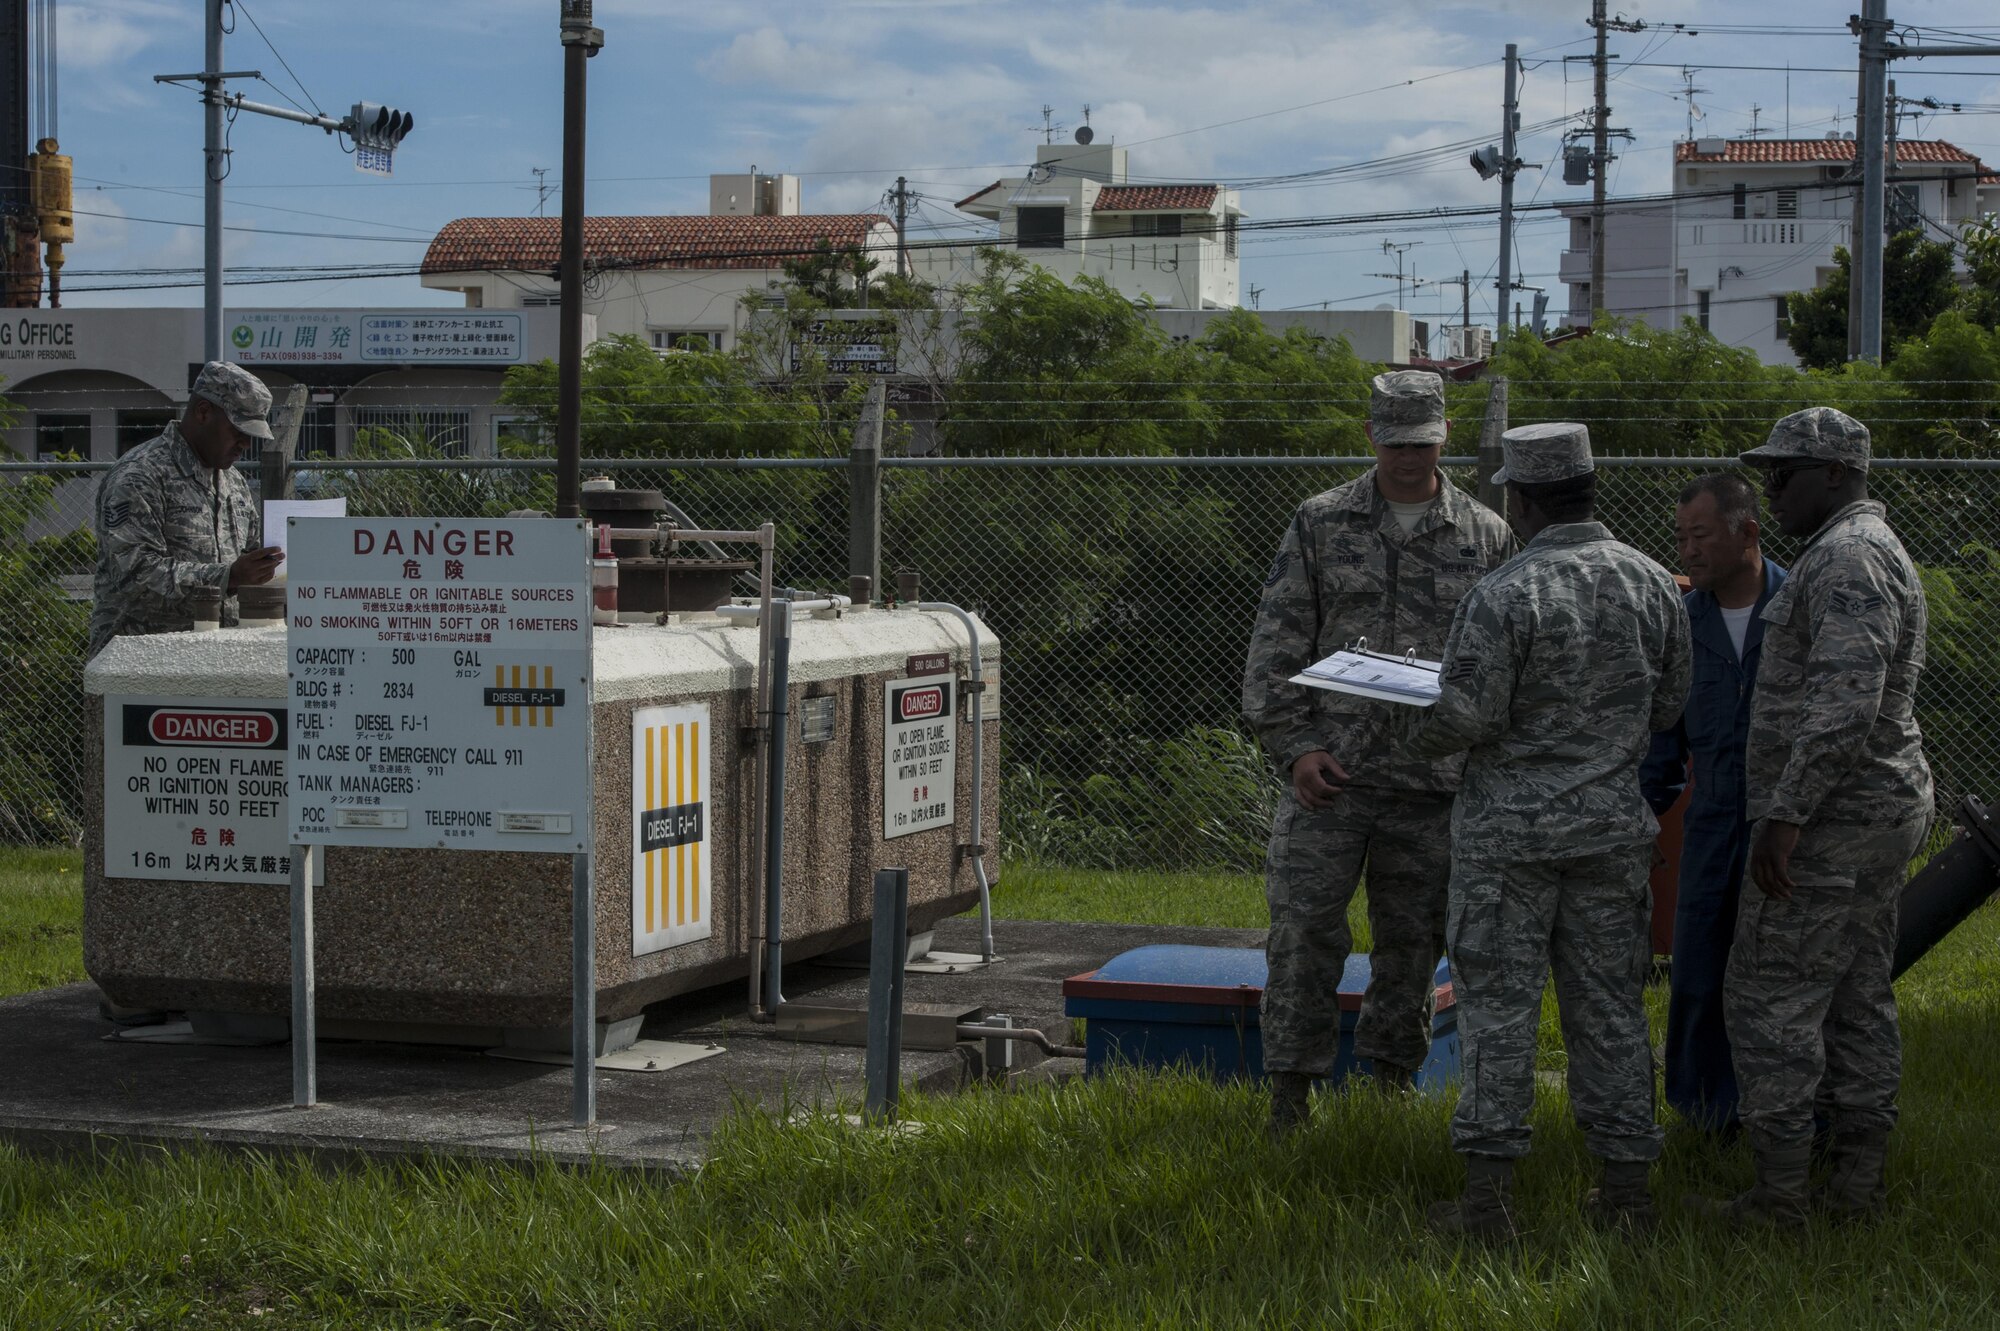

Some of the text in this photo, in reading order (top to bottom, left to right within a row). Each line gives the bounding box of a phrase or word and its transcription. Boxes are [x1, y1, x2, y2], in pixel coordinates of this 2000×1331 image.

[37, 350, 77, 360] PERSONNEL
[354, 529, 515, 556] DANGER
[1337, 554, 1365, 564] YOUNG
[298, 587, 574, 602] NO FLAMMABLE OR IGNITABLE SOURCES
[362, 602, 507, 614] 可燃性又は発火性物質の持ち込み禁止
[294, 616, 579, 632] NO SMOKING WITHIN 50FT OR 16METERS
[392, 648, 415, 665] 500
[454, 650, 481, 667] GAL
[914, 658, 945, 671] 500 GALLONS
[304, 667, 345, 676] タンク容量
[455, 669, 481, 678] ガロン
[296, 681, 327, 697] BLDG
[333, 682, 341, 697] #
[383, 682, 414, 699] 2834
[492, 692, 556, 704] DIESEL FJ-1
[304, 700, 337, 710] 建物番号
[906, 694, 937, 713] DANGER
[165, 717, 259, 740] DANGER
[355, 714, 394, 731] DIESEL
[401, 715, 428, 731] FJ-1
[303, 731, 320, 740] 燃料
[356, 731, 393, 741] ディーゼル
[899, 725, 944, 745] NO OPEN FLAME
[297, 744, 522, 766] IN CASE OF EMERGENCY CALL 911
[893, 739, 950, 763] OR IGNITION SOURCE
[144, 756, 284, 777] NO OPEN FLAME
[369, 764, 444, 776] 緊急連絡先 911
[899, 759, 942, 780] WITHIN 50 FEET
[128, 777, 150, 793] OR
[159, 778, 228, 795] IGNITION
[298, 775, 332, 791] TANK
[145, 797, 280, 818] WITHIN 50 FEET
[330, 795, 381, 805] タンク責任者
[303, 807, 325, 822] POC
[425, 810, 492, 827] TELEPHONE
[648, 813, 697, 841] DIESEL FJ-1
[132, 852, 171, 869] 16m
